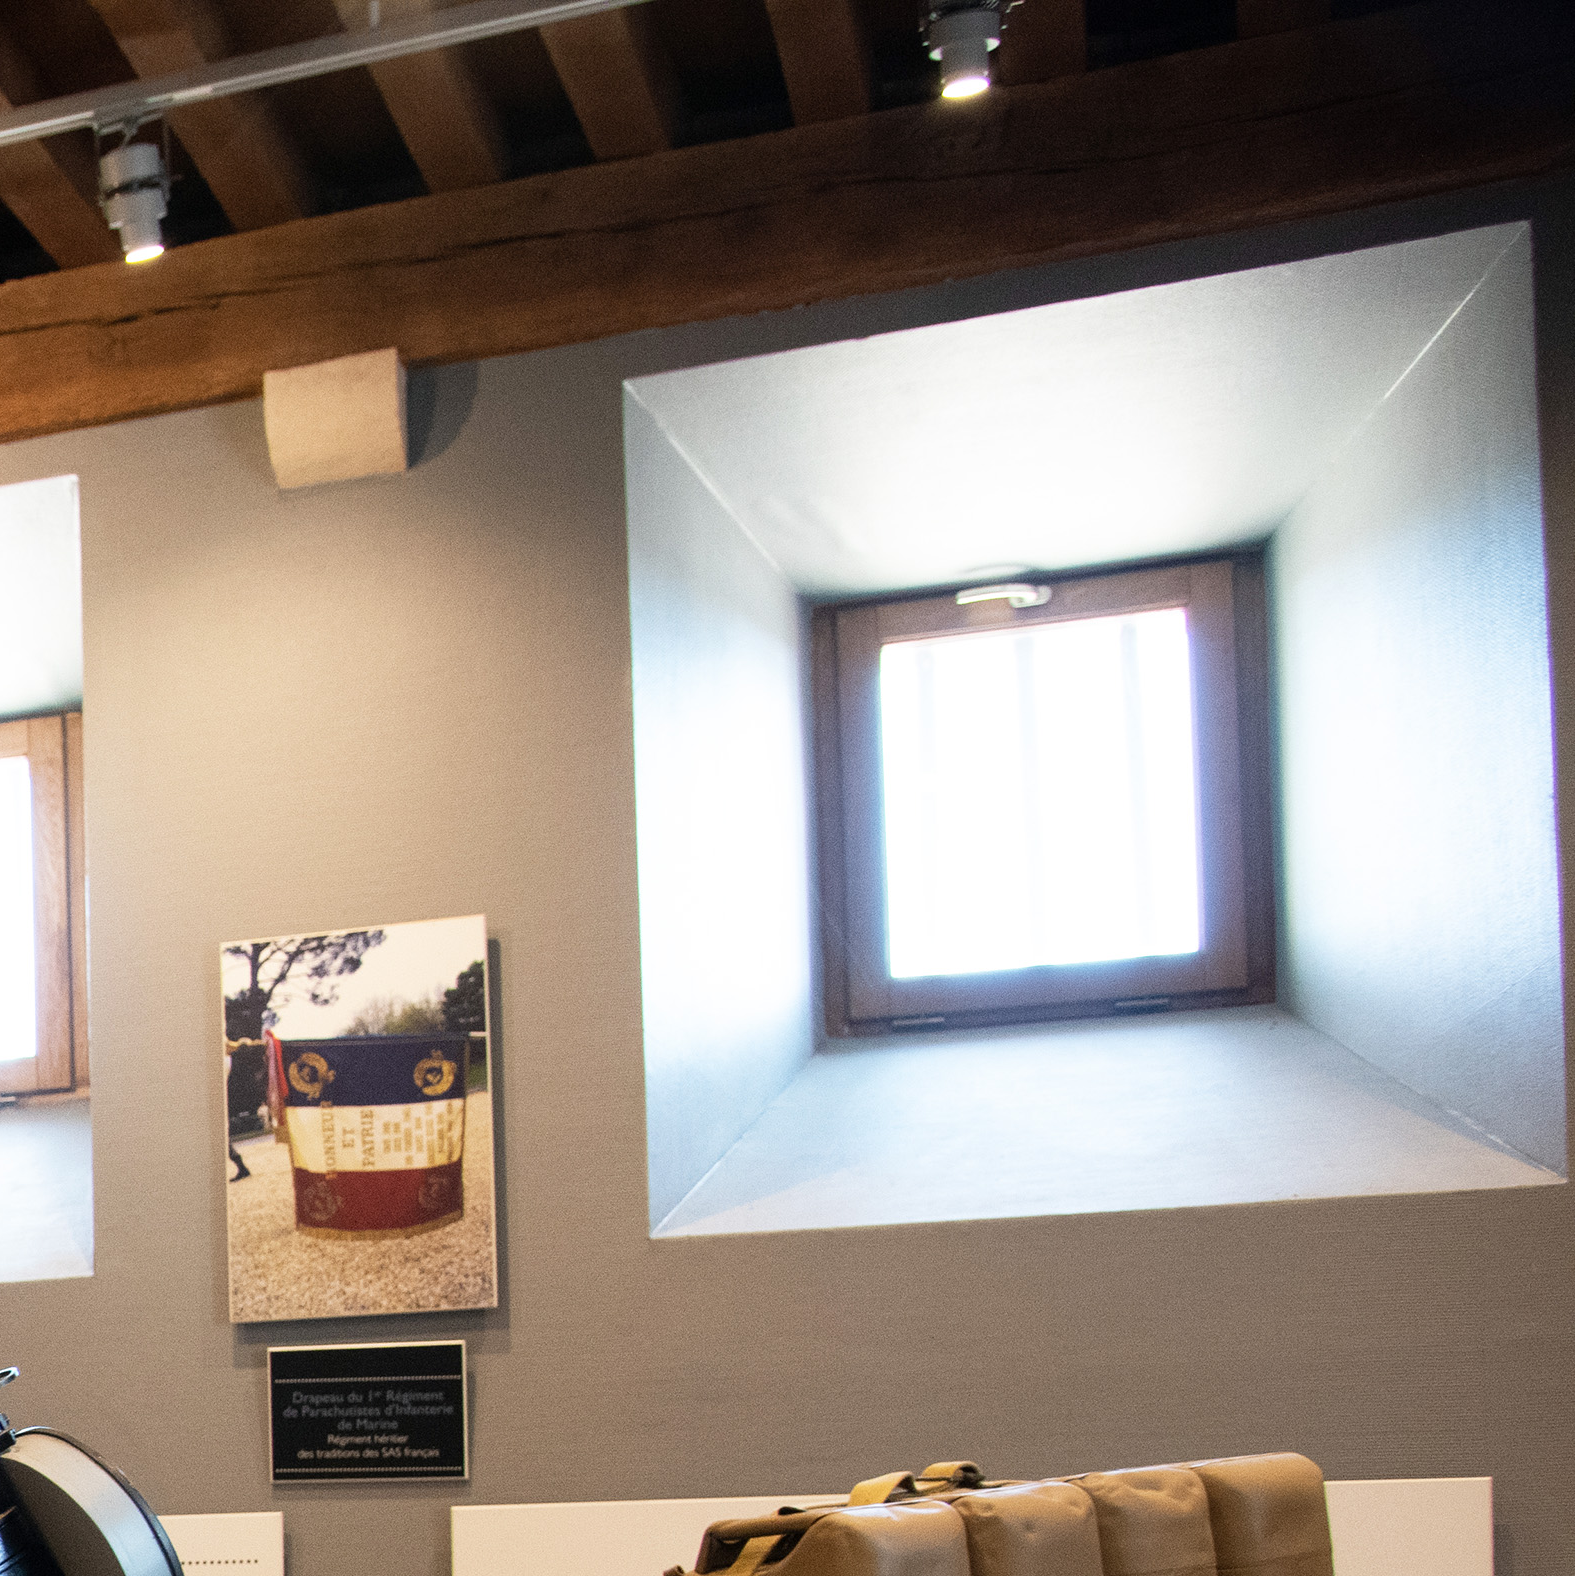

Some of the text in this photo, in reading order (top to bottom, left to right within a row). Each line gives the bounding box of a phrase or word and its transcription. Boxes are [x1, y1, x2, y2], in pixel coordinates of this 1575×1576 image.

[360, 1110, 375, 1167] PATRIE
[292, 1391, 344, 1405] Drapeau
[347, 1391, 363, 1402] du
[386, 1390, 444, 1404] Régiment
[282, 1408, 298, 1418] de
[301, 1406, 381, 1417] Parachutistes
[337, 1419, 399, 1430] de Marine
